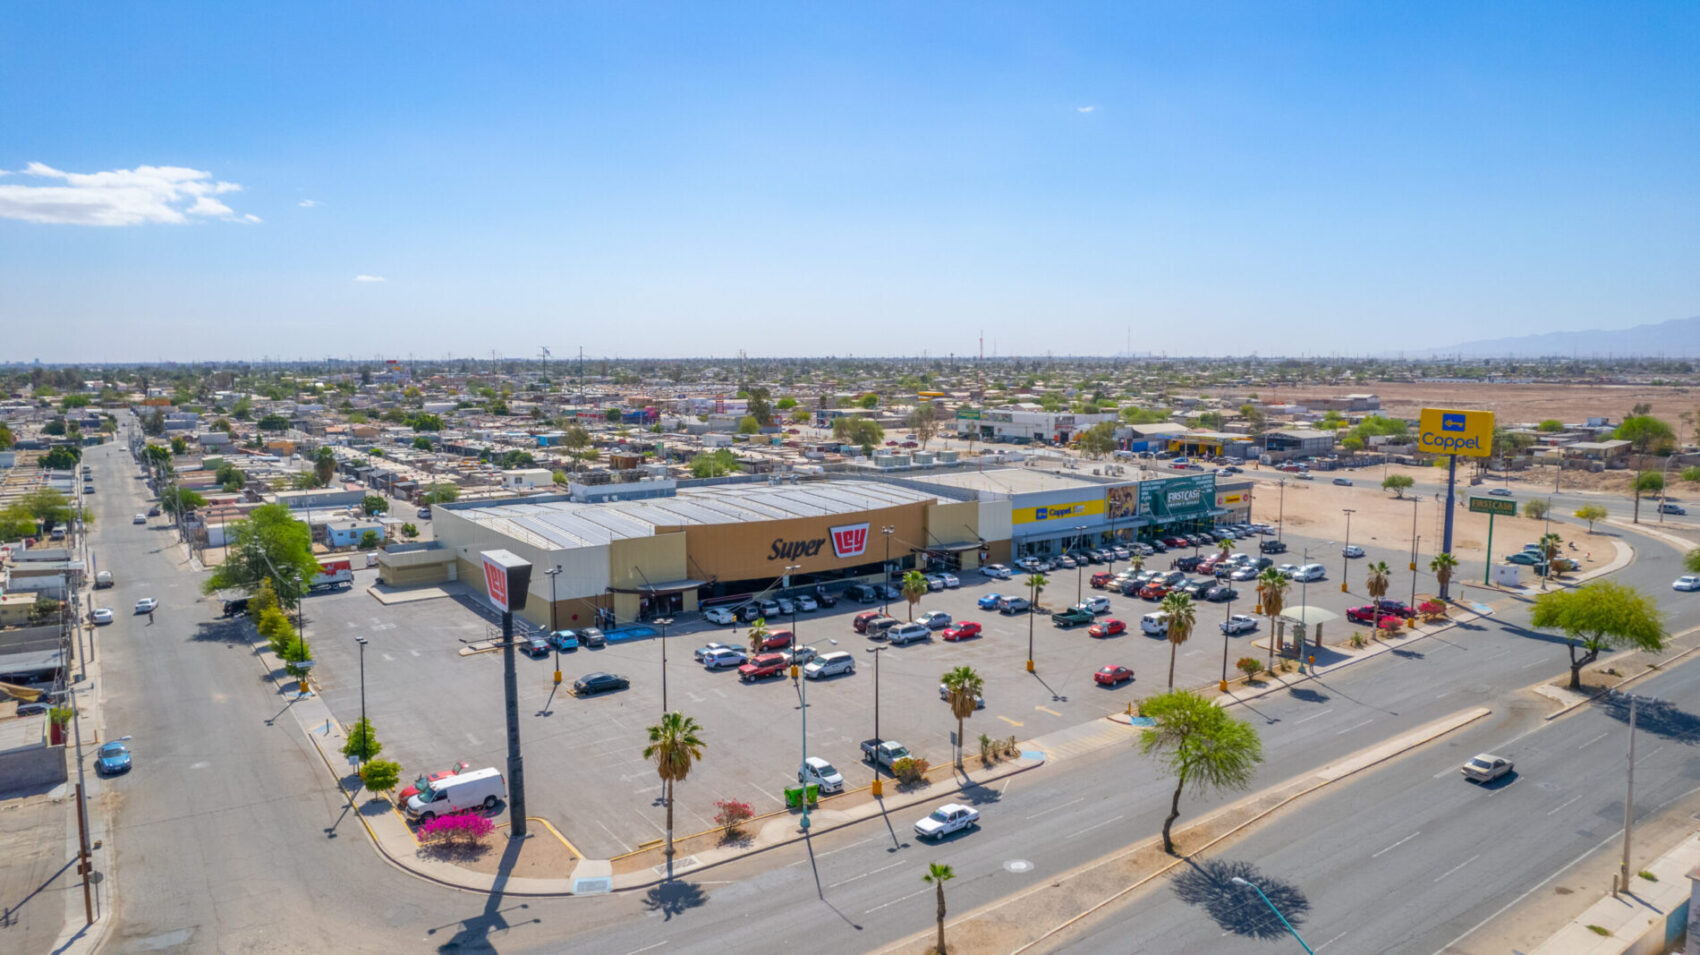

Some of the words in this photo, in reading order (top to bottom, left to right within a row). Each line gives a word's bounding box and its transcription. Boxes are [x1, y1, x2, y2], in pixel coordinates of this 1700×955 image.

[1422, 432, 1480, 451] Coppel
[1049, 507, 1072, 518] Coppel
[767, 538, 826, 562] Super
